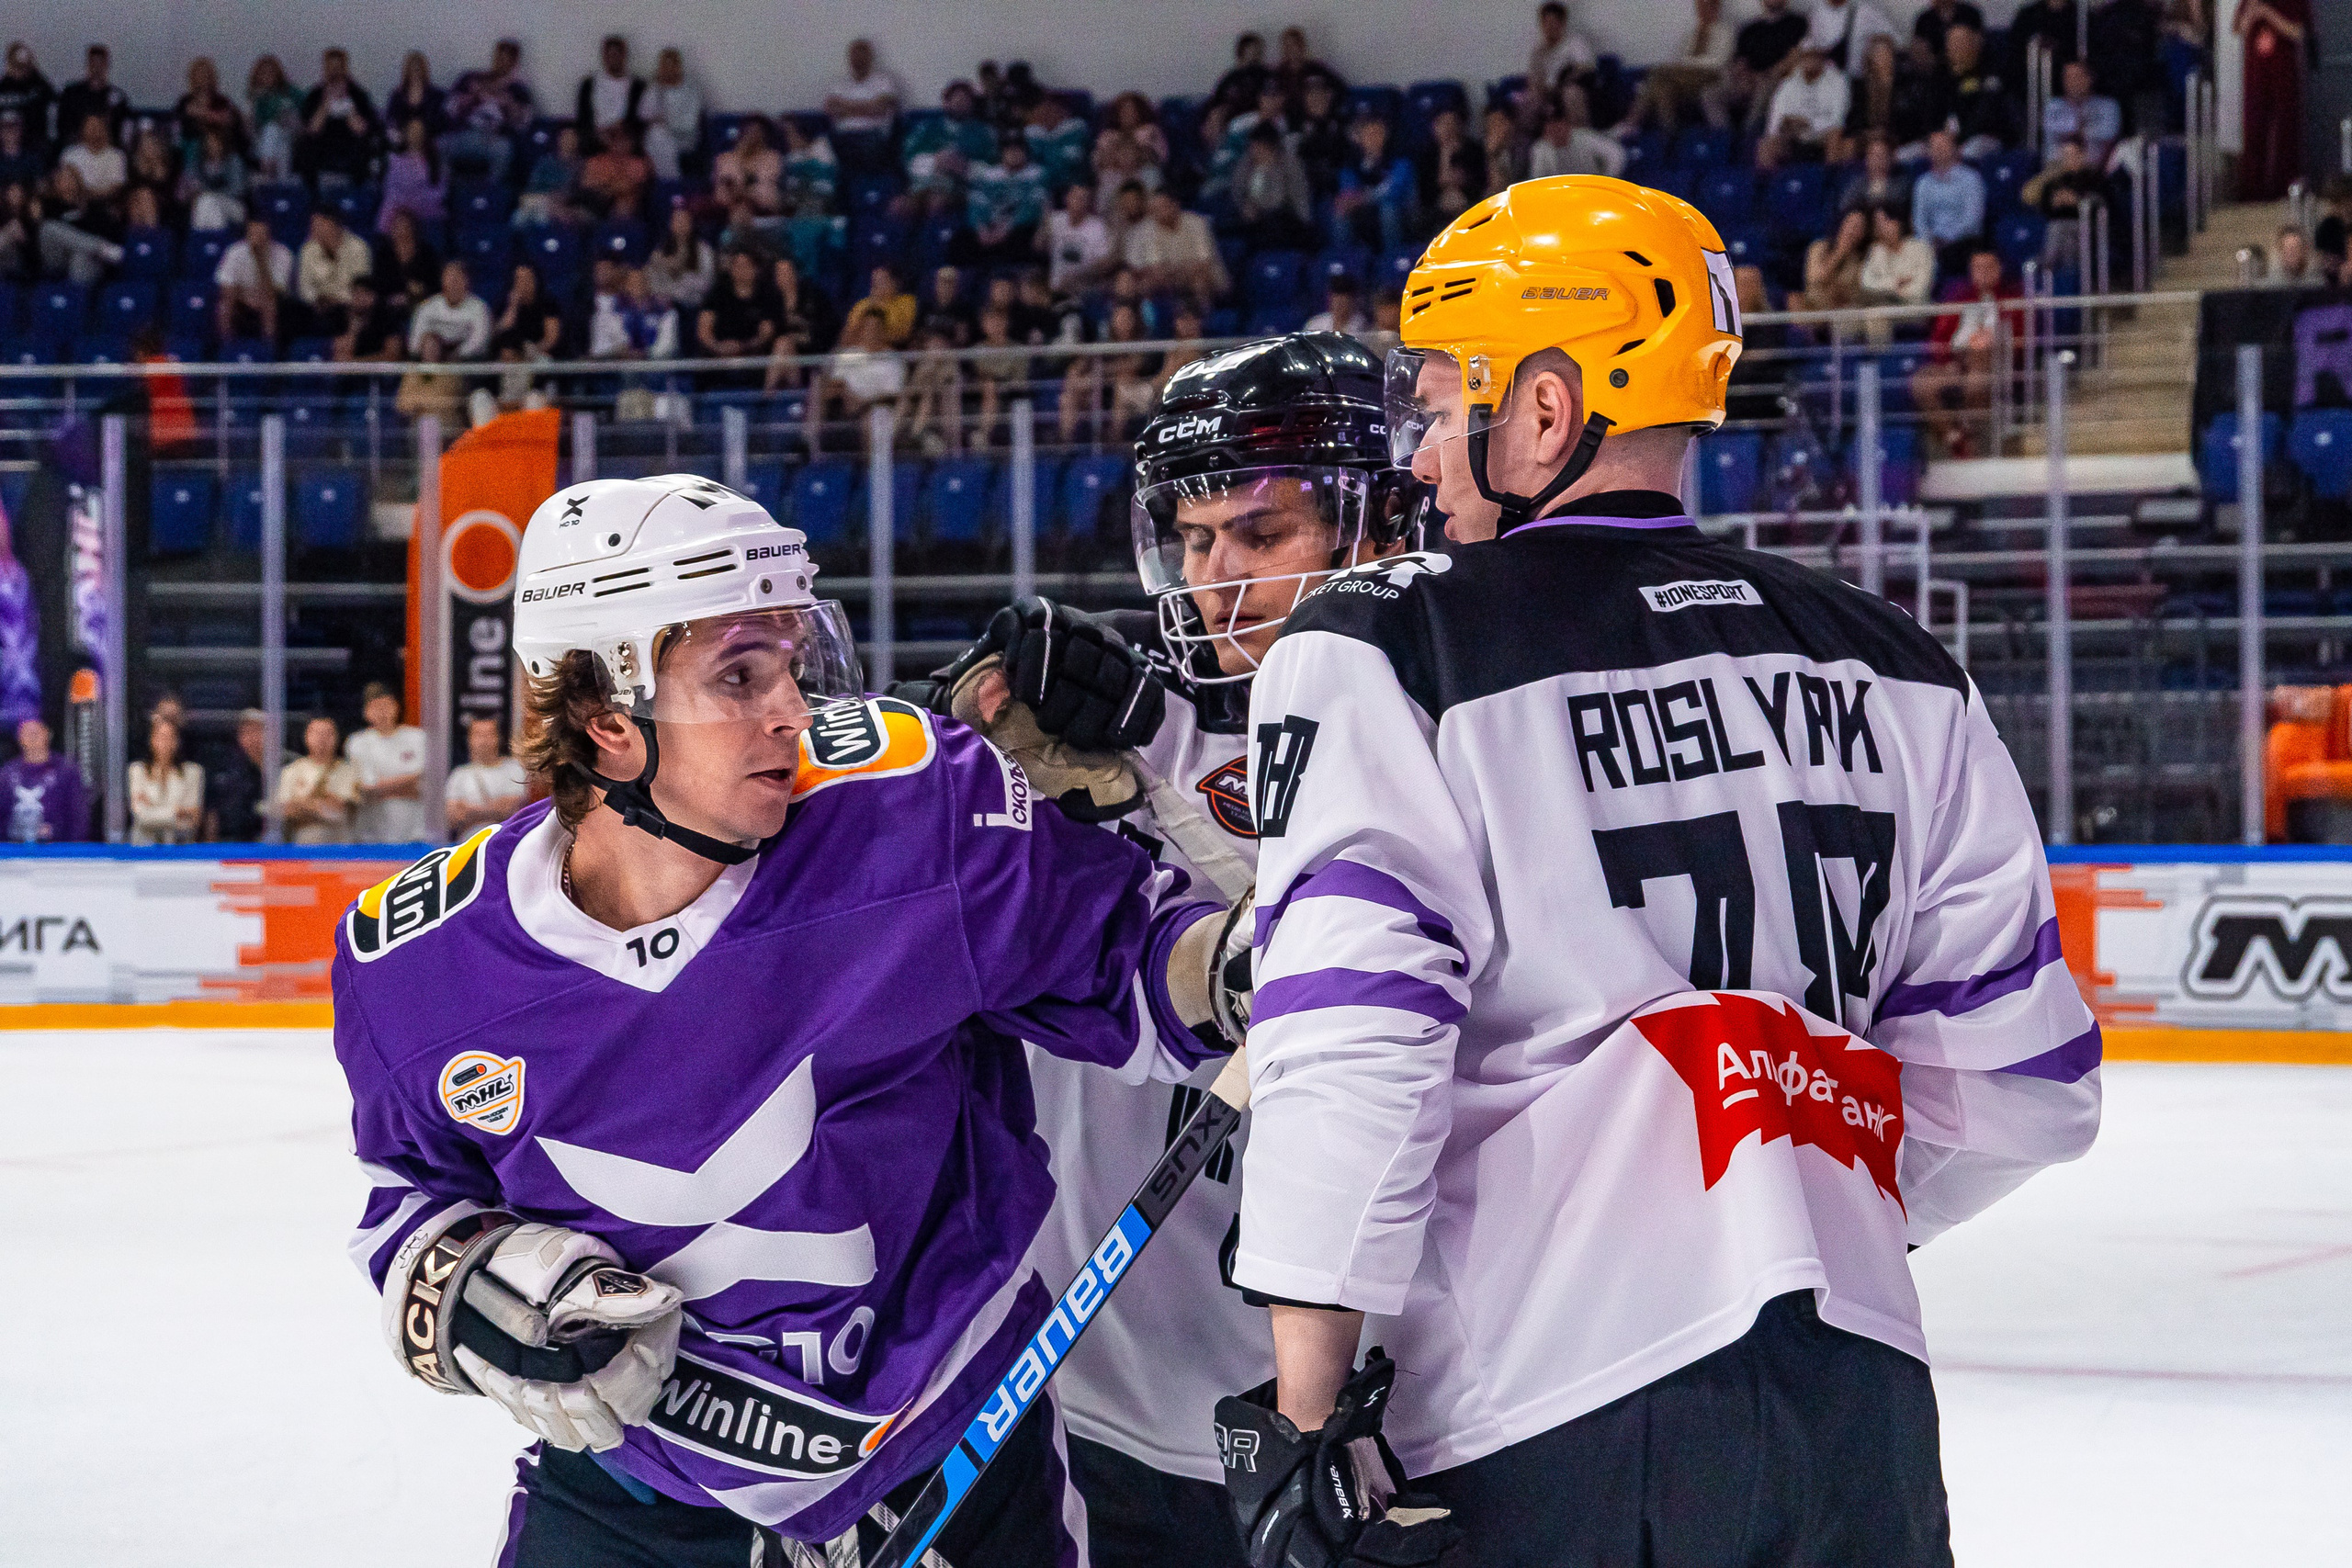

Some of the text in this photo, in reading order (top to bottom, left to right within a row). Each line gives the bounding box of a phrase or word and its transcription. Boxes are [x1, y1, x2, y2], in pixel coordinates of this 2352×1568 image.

[1521, 286, 1611, 300] BAUER
[1158, 416, 1222, 443] CCM
[746, 544, 801, 560] BAUER
[521, 581, 586, 603] BAUER
[1338, 580, 1399, 600] GROUP
[626, 927, 680, 968] 10
[454, 1078, 512, 1111] MHL
[781, 1305, 876, 1386] 10
[977, 1224, 1134, 1443] BAUER
[651, 1378, 842, 1465] Winline
